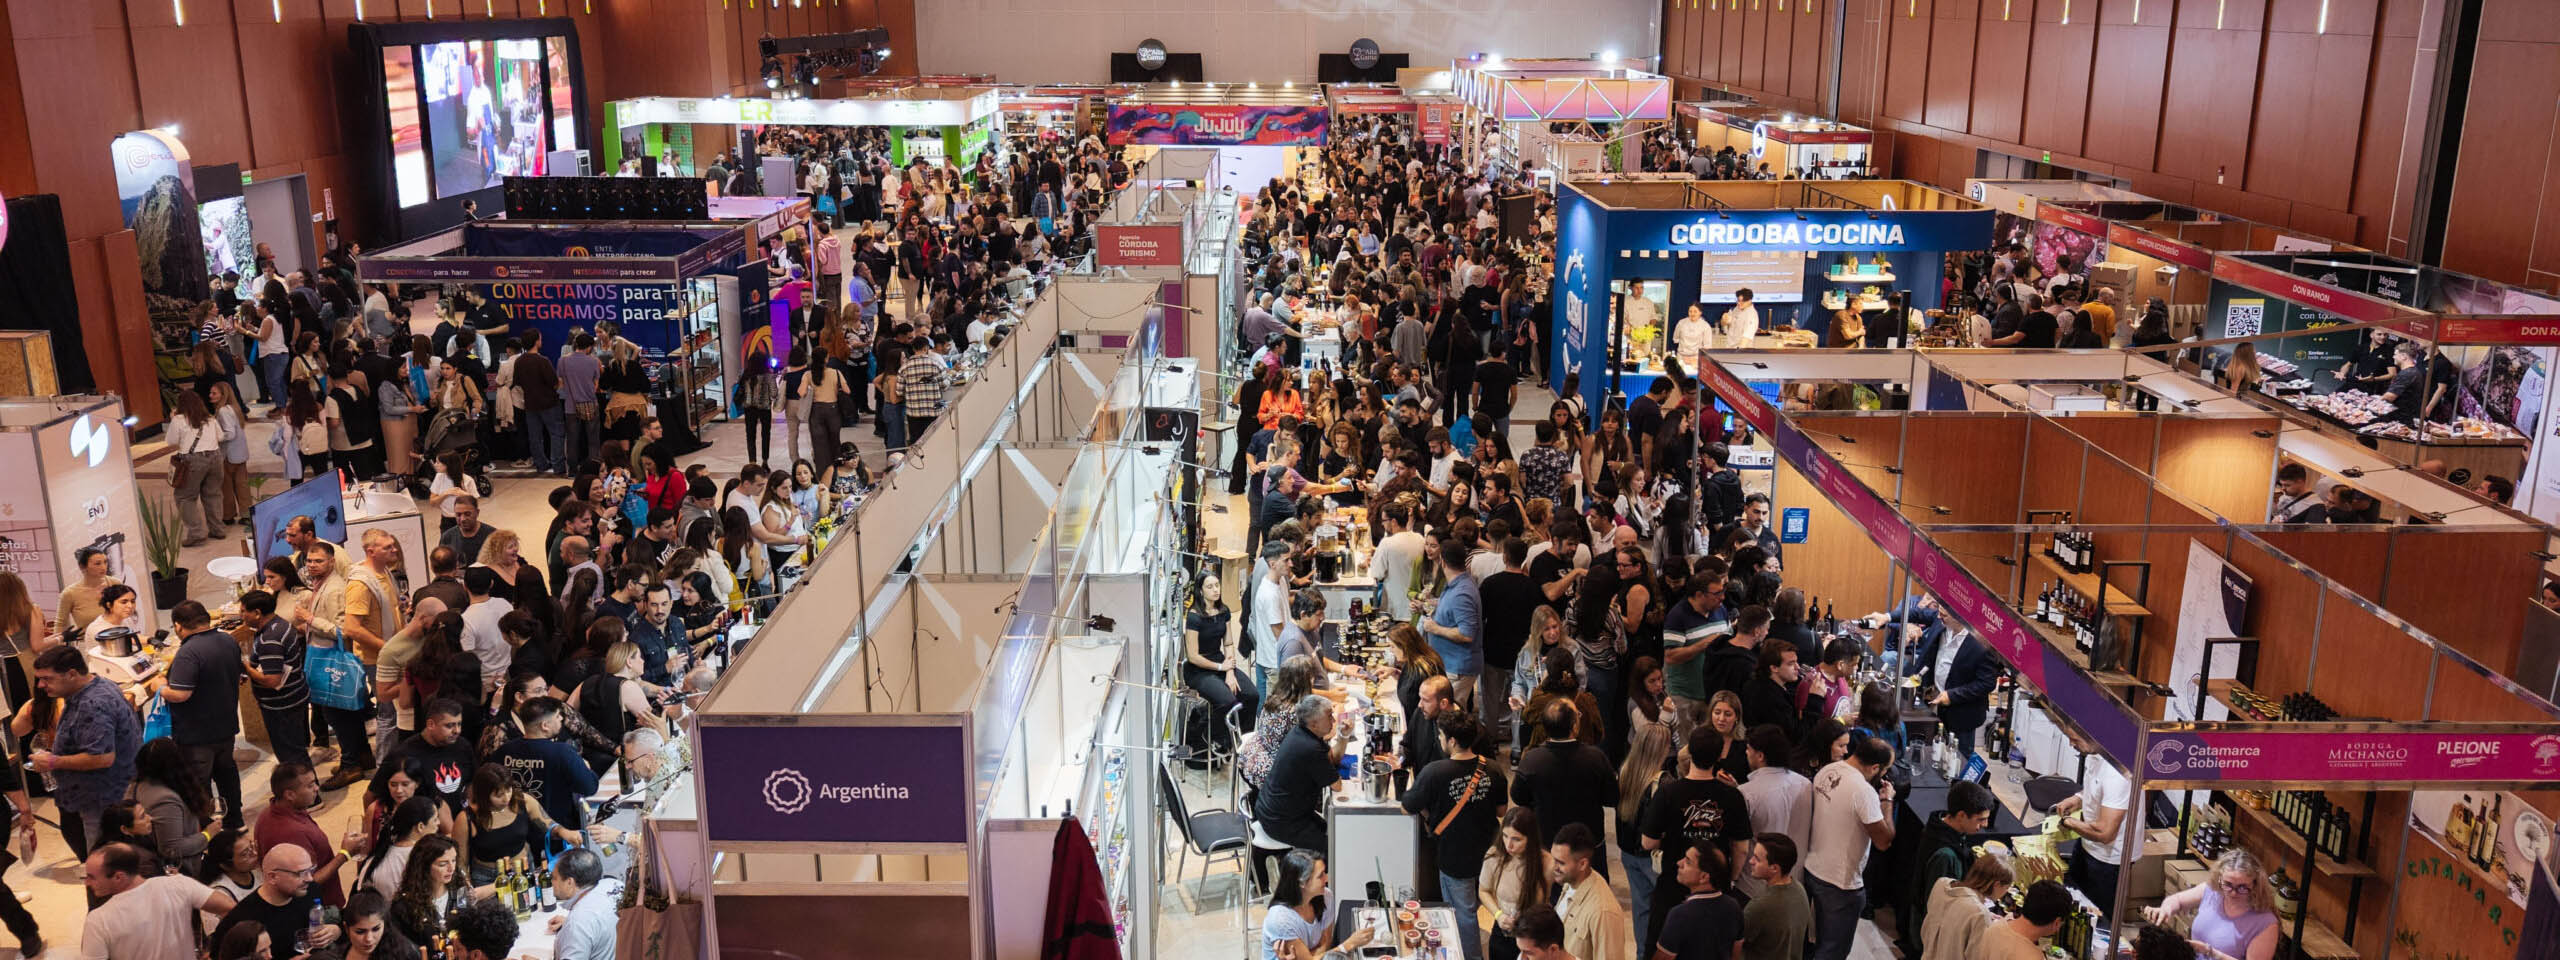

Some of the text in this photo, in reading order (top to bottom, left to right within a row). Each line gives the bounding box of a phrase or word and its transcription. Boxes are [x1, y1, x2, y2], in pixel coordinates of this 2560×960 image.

[678, 100, 697, 112] ER
[740, 101, 773, 121] ER
[1671, 217, 1905, 245] CÓRDOBA COCINA
[1119, 239, 1159, 248] CÓRDOBA
[1120, 249, 1157, 257] TURISMO
[433, 269, 449, 277] para
[451, 268, 470, 276] hacer
[619, 269, 635, 277] para
[2378, 274, 2398, 289] Mejor
[492, 283, 618, 300] CONECTAMOS
[622, 287, 663, 304] para
[2292, 284, 2331, 304] DON RAMON
[2377, 286, 2401, 299] salame
[500, 303, 663, 324] NTEGRAMOS para
[2520, 326, 2549, 337] DON
[1981, 601, 2004, 632] PLEIONE
[2188, 744, 2261, 757] Catamarca
[2346, 742, 2392, 750] BODEGA
[2436, 740, 2501, 756] PLEIONE
[503, 754, 545, 769] Dream
[2186, 756, 2249, 769] Gobierno
[819, 782, 909, 804] Argentina
